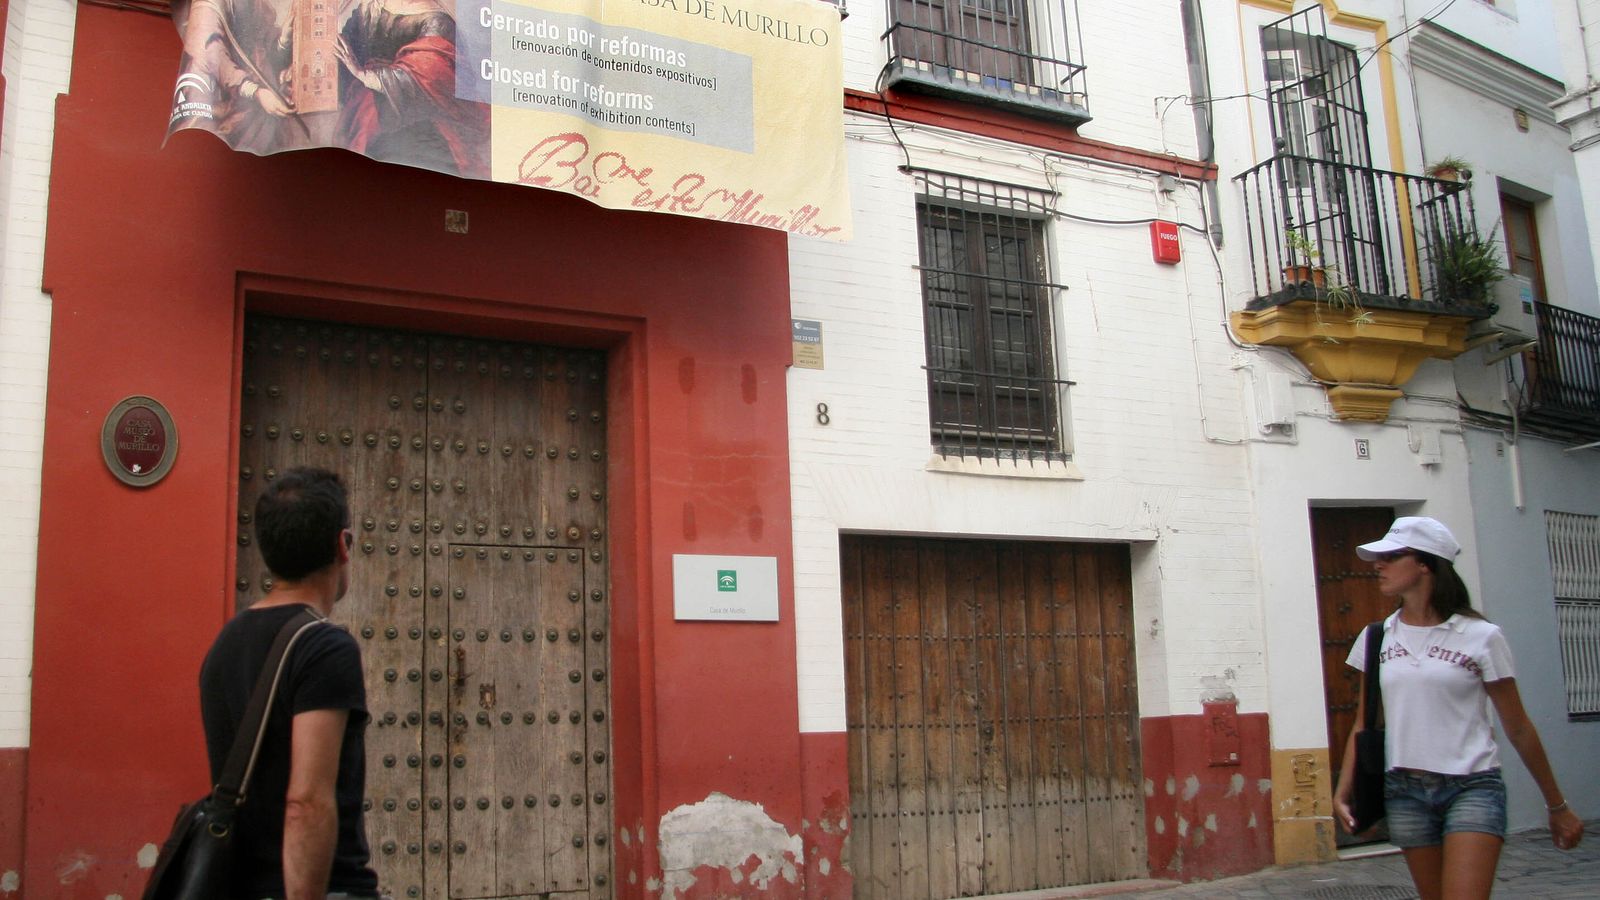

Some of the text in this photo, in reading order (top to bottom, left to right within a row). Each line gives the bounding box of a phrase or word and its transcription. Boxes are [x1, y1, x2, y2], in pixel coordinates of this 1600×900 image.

[480, 6, 687, 67] Cerrado por reformas
[685, 0, 829, 47] DE MURILLO
[512, 36, 717, 91] [renovación de contenidos expositivos]
[480, 59, 654, 110] Closed for reforms
[513, 88, 696, 136] [renovation of exhibition contents]
[1160, 233, 1178, 241] FUEGO
[817, 402, 830, 425] 8
[118, 440, 160, 452] MURILLO
[133, 435, 147, 443] DE
[1359, 443, 1366, 455] 6
